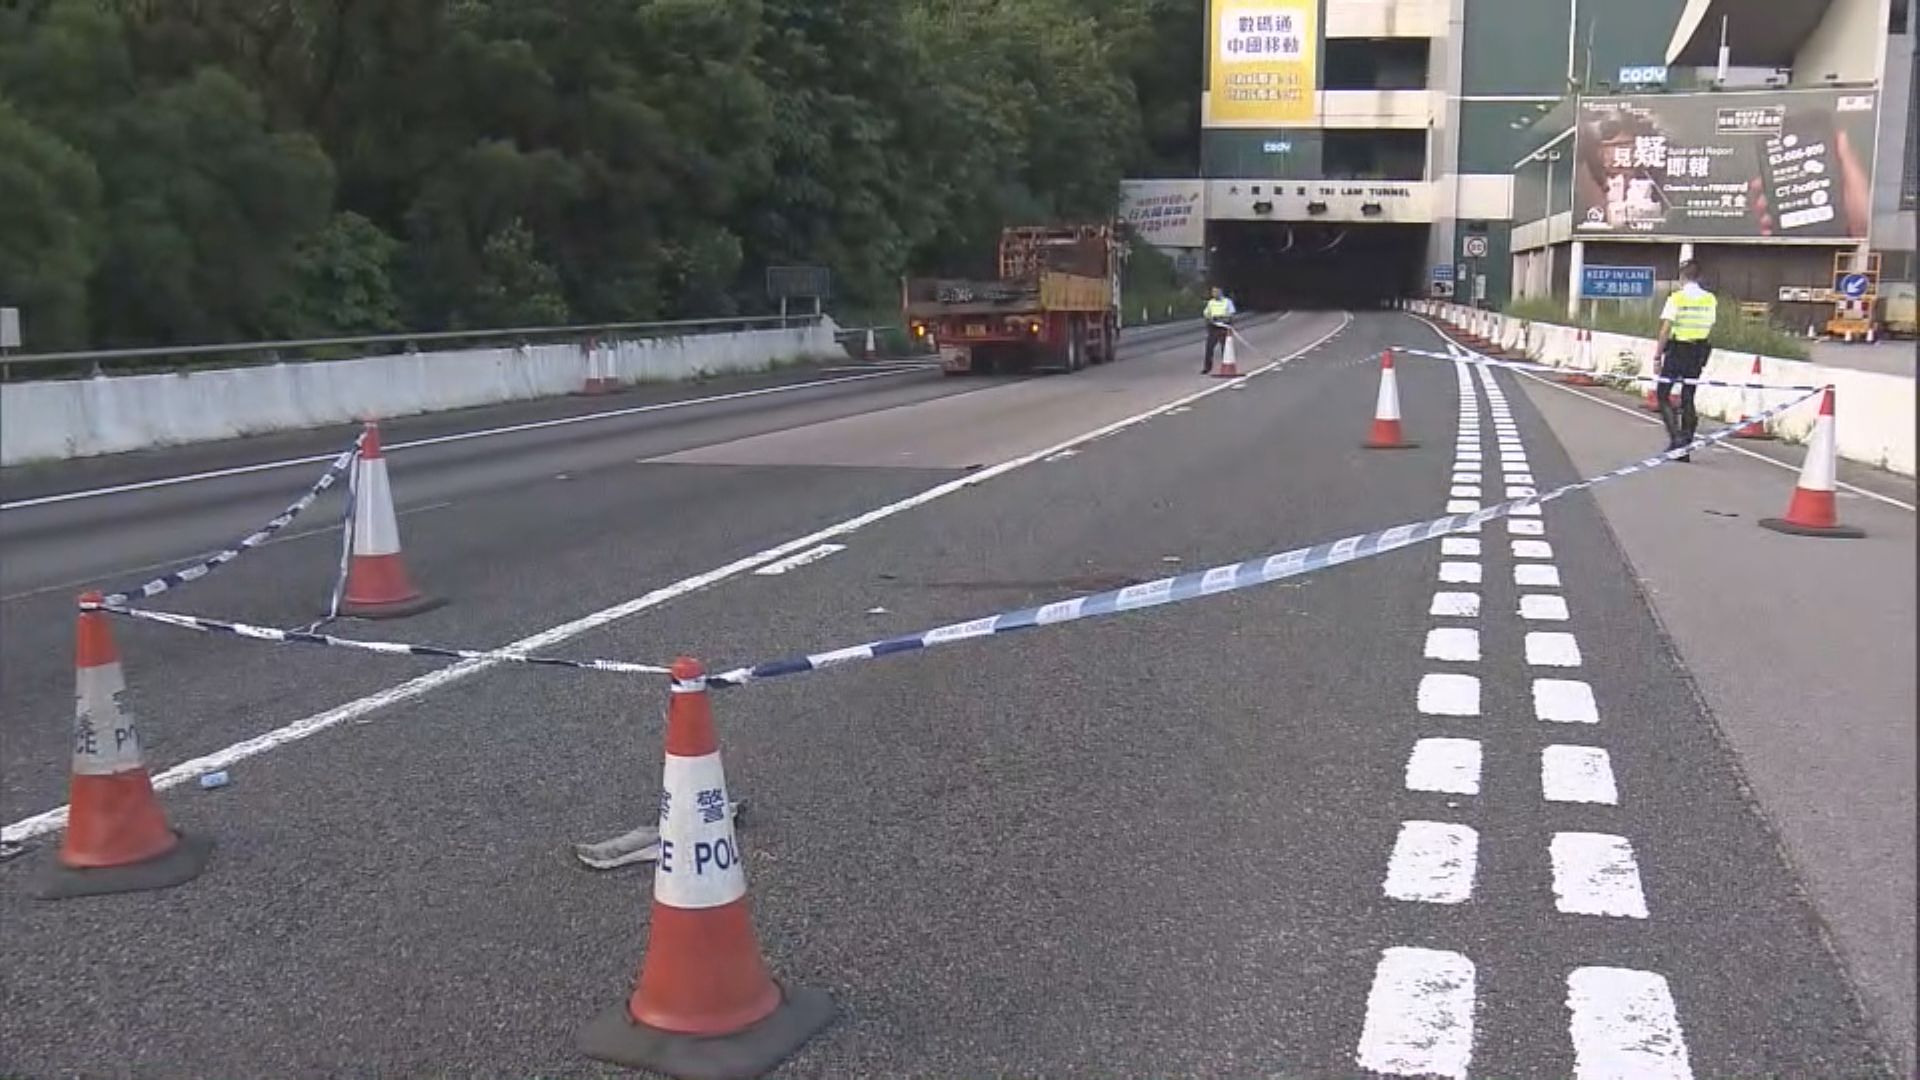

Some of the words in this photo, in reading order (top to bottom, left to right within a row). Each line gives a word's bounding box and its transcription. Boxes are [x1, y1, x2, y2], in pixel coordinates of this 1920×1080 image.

[1238, 15, 1292, 33] 數碼通
[1226, 36, 1299, 54] 中國移動
[1620, 66, 1666, 82] cody
[1368, 188, 1411, 197] TUNNEL
[1586, 269, 1611, 280] KEEP
[1625, 271, 1651, 281] LANE
[695, 788, 725, 824] 警
